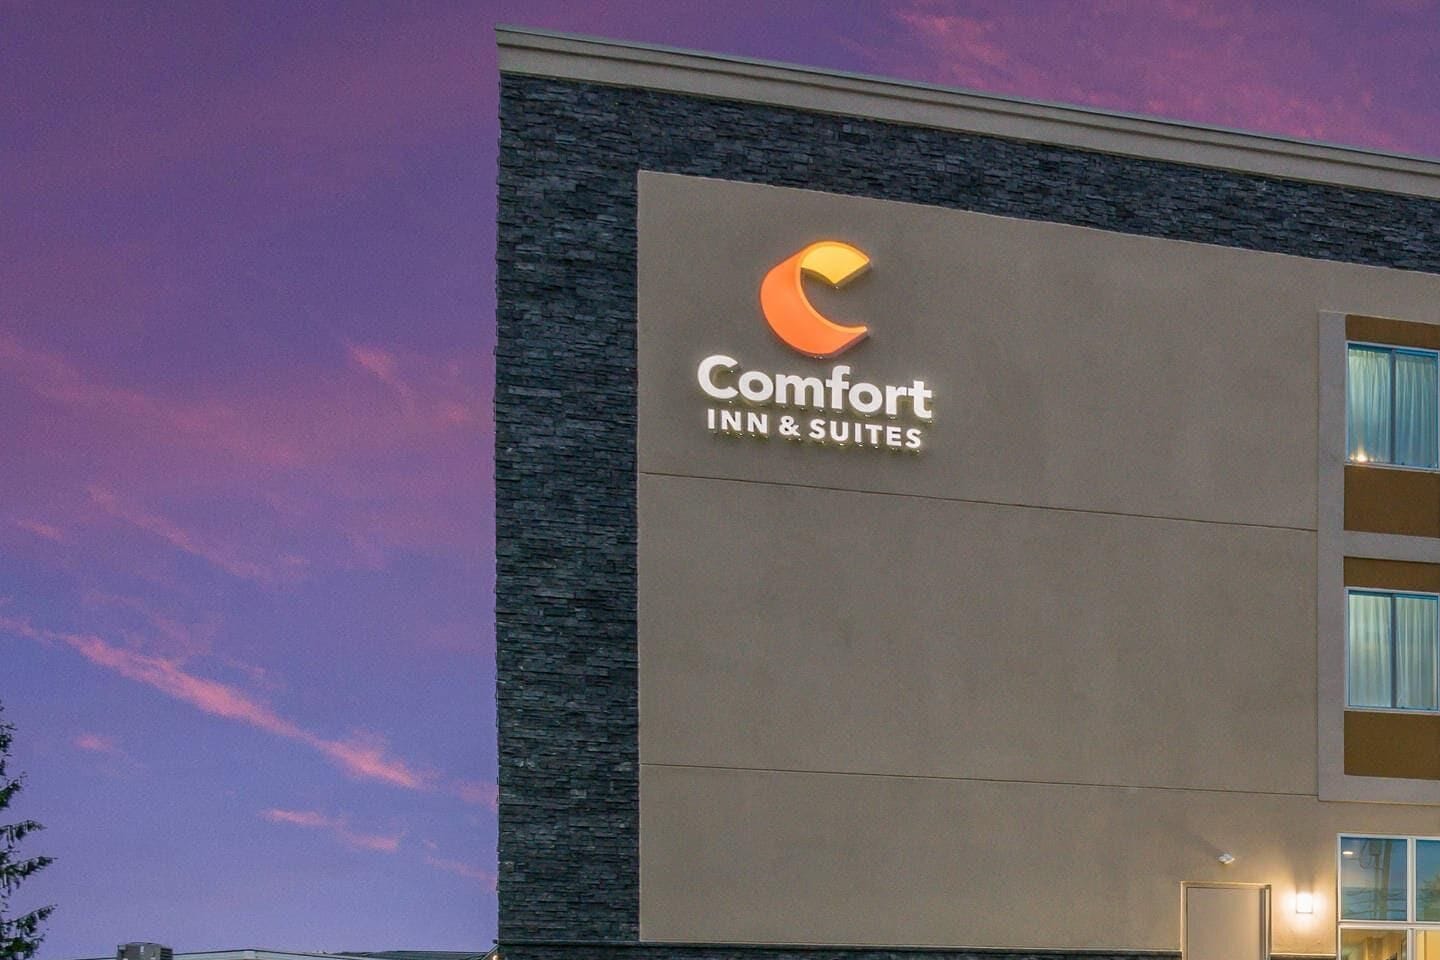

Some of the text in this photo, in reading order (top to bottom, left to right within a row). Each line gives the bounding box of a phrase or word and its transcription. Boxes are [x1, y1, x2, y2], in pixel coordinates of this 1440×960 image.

[697, 355, 933, 419] Comfort
[707, 408, 922, 449] INN & SUITES
